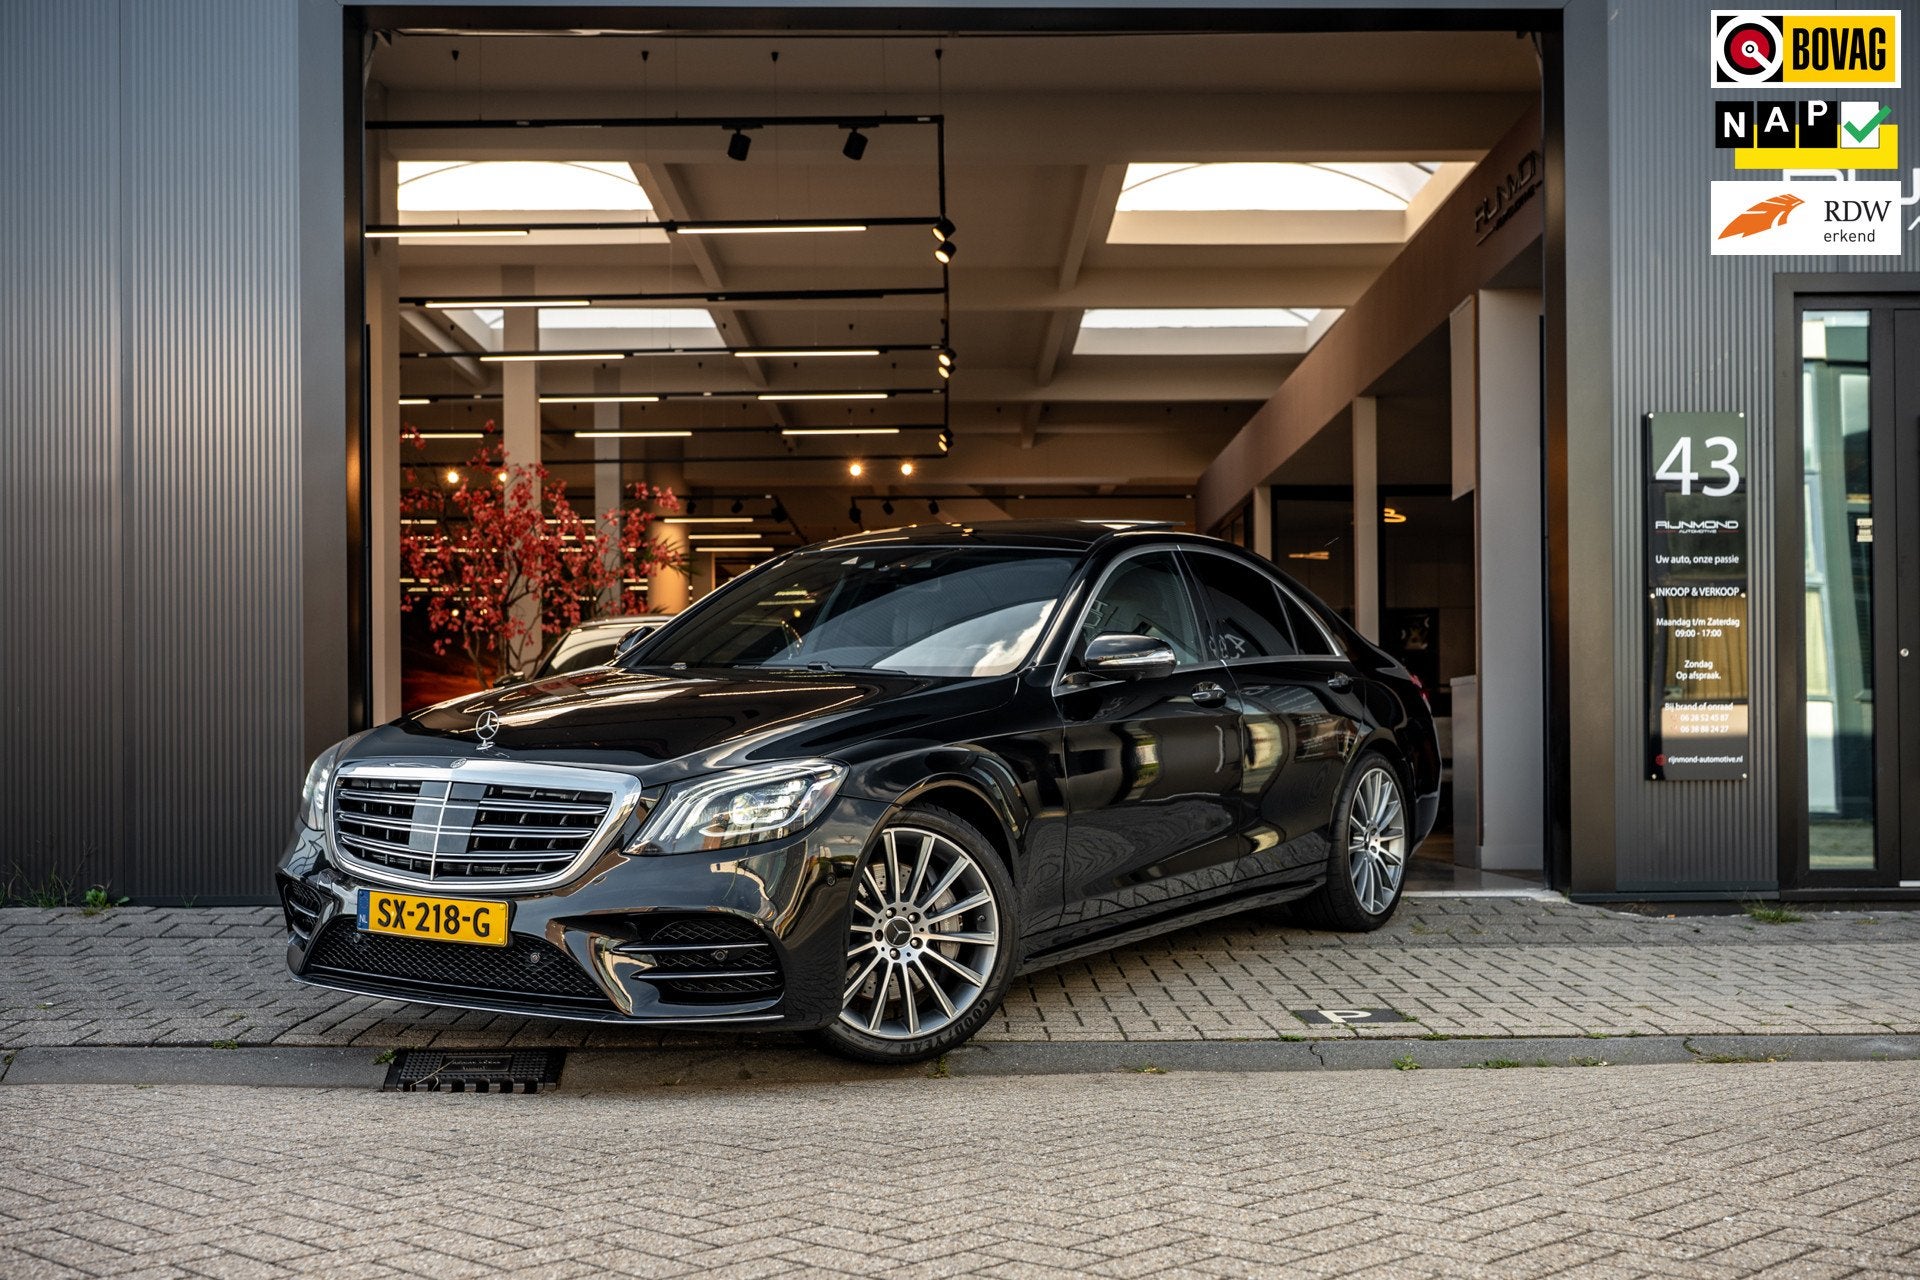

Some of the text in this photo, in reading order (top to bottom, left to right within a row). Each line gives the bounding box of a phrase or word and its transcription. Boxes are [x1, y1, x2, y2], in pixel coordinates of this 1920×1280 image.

[1655, 436, 1740, 497] 43
[1655, 520, 1739, 529] RIJNMOND
[1655, 555, 1739, 565] Uw auto, onze passie
[1655, 586, 1740, 597] INKOOP & VERKOOP
[1656, 617, 1740, 628] Maandag t/m Zaterdag
[1675, 629, 1696, 638] 09:00
[1702, 629, 1722, 638] 17:00
[1684, 660, 1713, 670] Zondag
[1675, 671, 1721, 681] Op afspraak.
[1675, 702, 1698, 711] brand
[1699, 702, 1707, 711] of
[1668, 755, 1743, 765] rijnmond-automotive.nl
[359, 913, 368, 924] NL
[377, 898, 490, 938] SX-218-G
[1318, 1010, 1372, 1023] P
